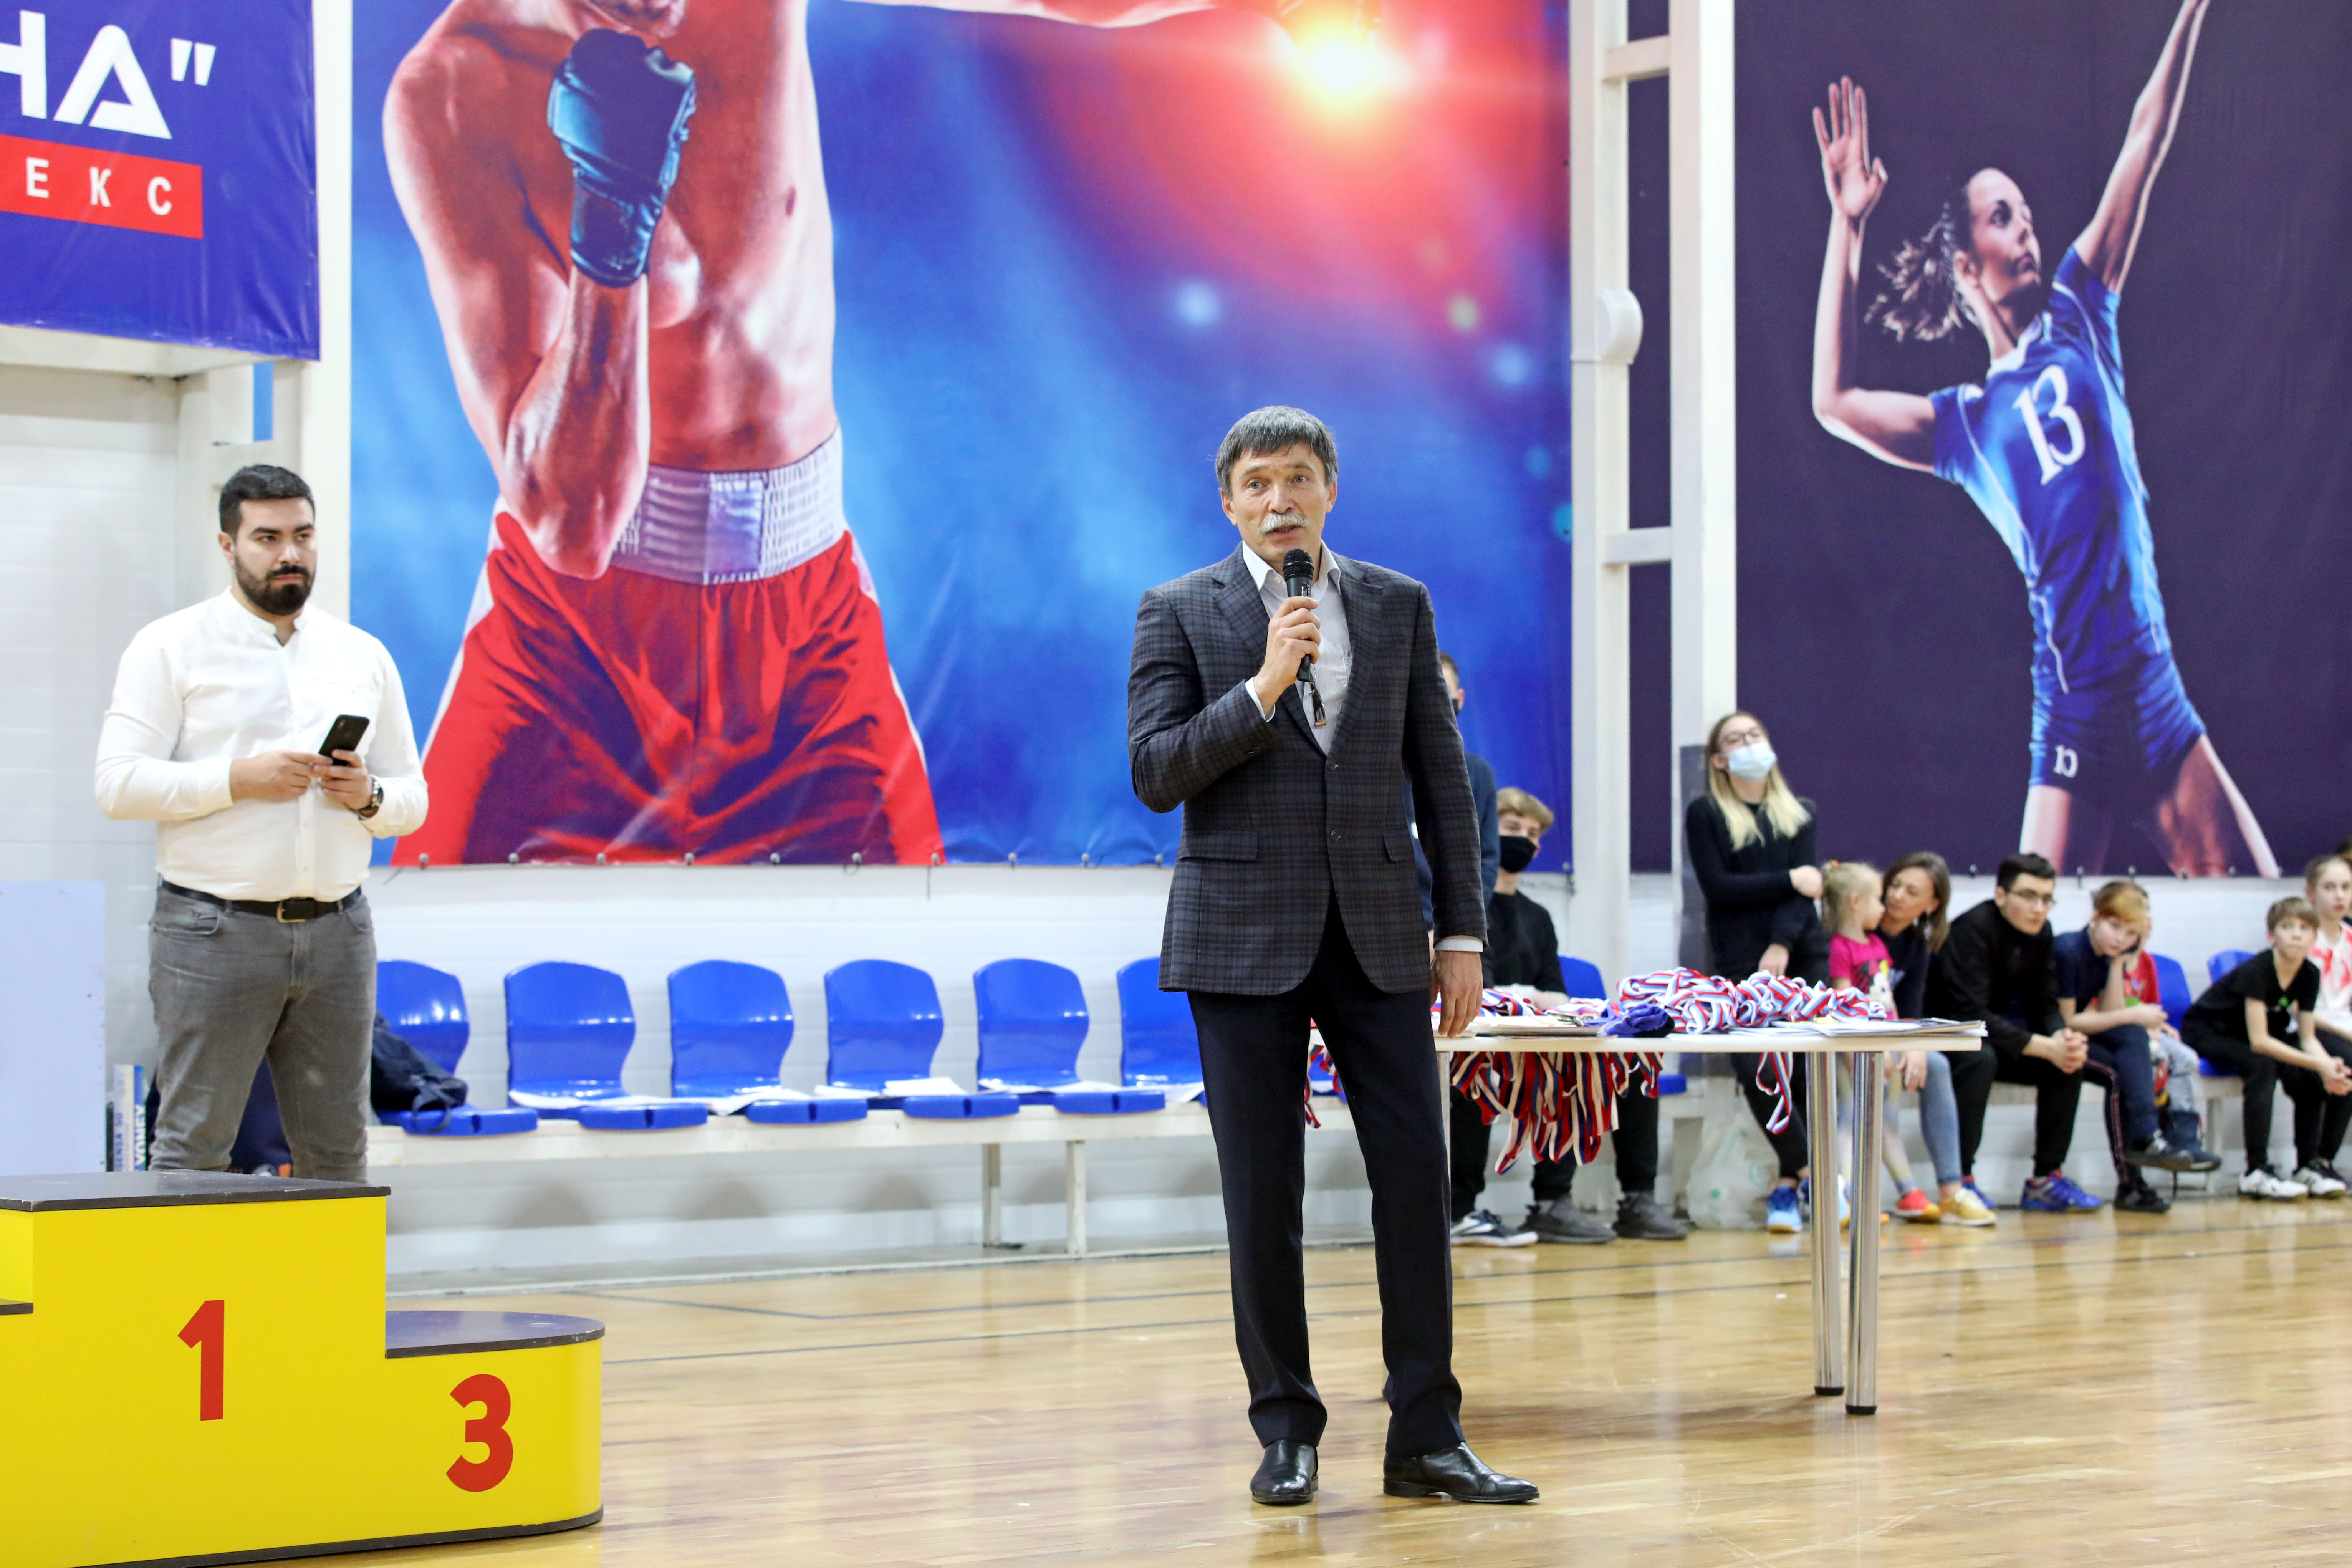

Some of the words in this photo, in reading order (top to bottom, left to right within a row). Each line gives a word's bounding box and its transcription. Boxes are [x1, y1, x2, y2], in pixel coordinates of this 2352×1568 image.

[26, 157, 172, 215] ЕКС
[2013, 365, 2085, 485] 13
[178, 1300, 225, 1421] 1
[446, 1373, 514, 1492] 3
